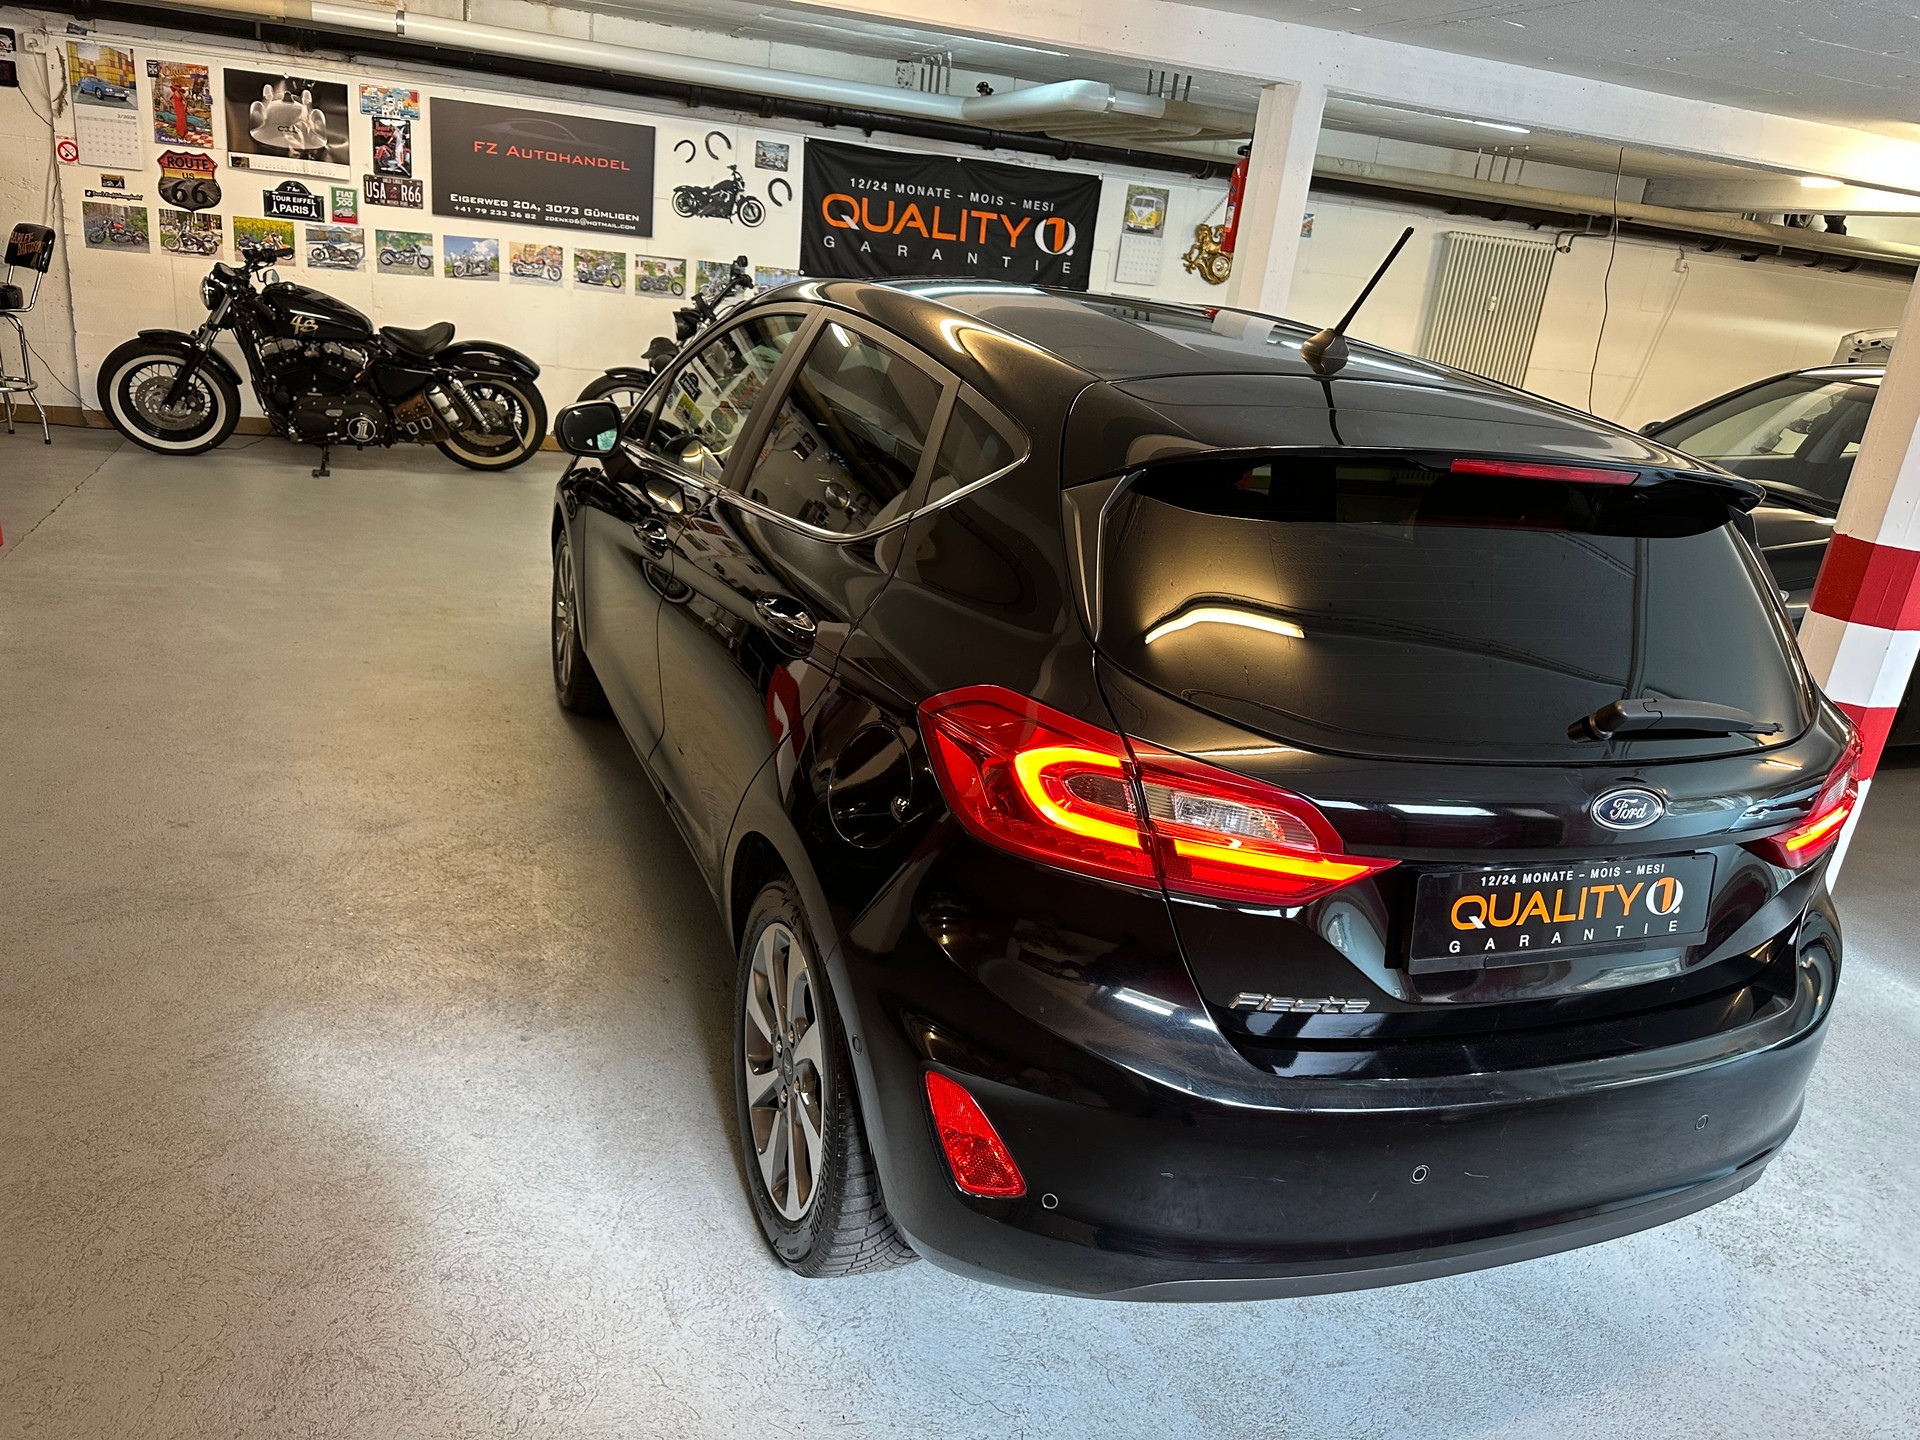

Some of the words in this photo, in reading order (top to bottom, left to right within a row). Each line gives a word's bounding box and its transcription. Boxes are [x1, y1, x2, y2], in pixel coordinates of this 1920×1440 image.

[167, 156, 209, 170] ROUTE
[473, 140, 498, 155] FZ
[506, 145, 630, 171] AUTOHANDEL
[182, 172, 195, 180] US
[171, 180, 208, 204] 66
[271, 194, 291, 202] TOUR
[293, 196, 316, 205] EIFFEL
[336, 190, 354, 198] FIAT
[336, 197, 354, 207] 500
[365, 181, 387, 200] USA
[401, 185, 421, 203] R66
[850, 178, 888, 192] 12/24
[895, 183, 951, 199] MONATE
[969, 192, 1004, 206] MOIS
[1022, 199, 1055, 212] MESI
[279, 204, 310, 215] PARIS
[450, 193, 509, 207] EIGERWEG
[545, 204, 579, 215] 3073
[583, 208, 640, 222] GÜMLIGEN
[454, 205, 471, 213] +41
[822, 193, 1032, 248] QUALITY
[823, 235, 1072, 274] GARANTIE
[1609, 798, 1648, 820] Ford
[1481, 874, 1517, 887] 12/24
[1522, 871, 1574, 884] MONATE
[1590, 867, 1621, 879] MOIS
[1636, 863, 1665, 875] MESI
[1450, 882, 1645, 931] QUALITY
[1449, 920, 1678, 954] GARANTIE
